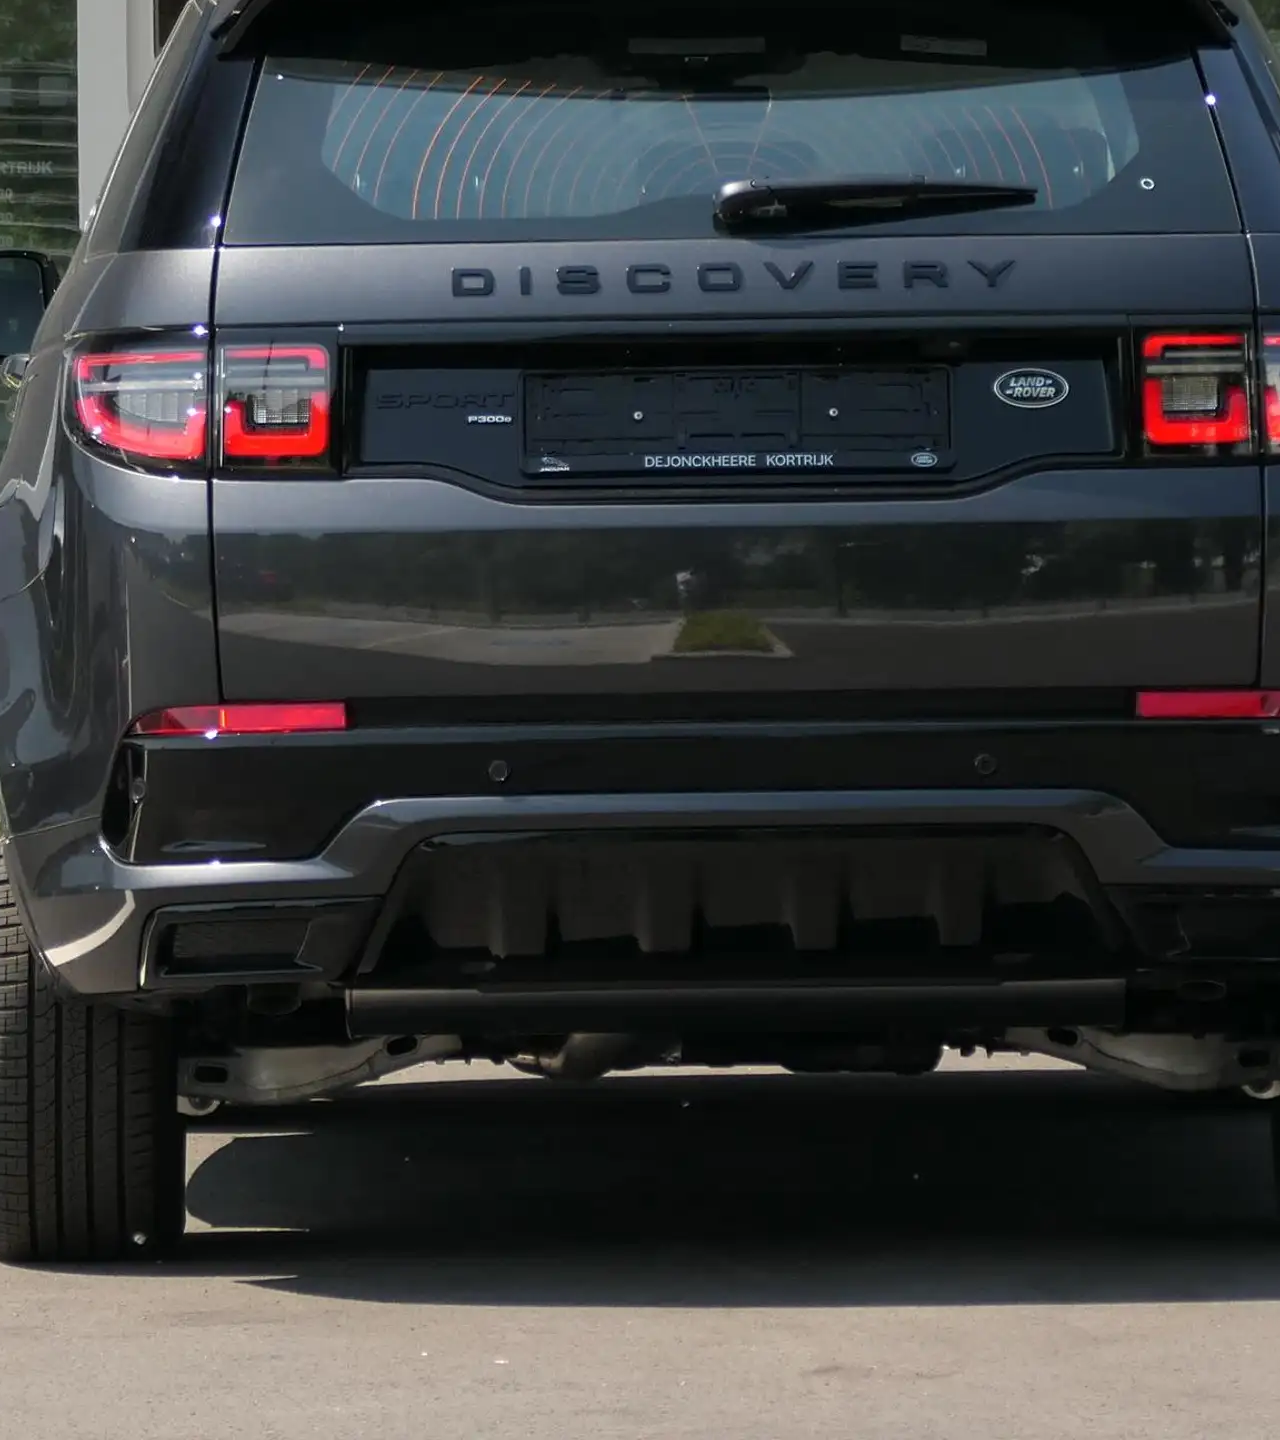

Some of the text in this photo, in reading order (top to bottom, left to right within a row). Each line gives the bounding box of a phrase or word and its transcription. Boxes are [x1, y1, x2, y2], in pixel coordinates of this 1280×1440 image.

[451, 259, 1016, 298] DISCOVERY
[1009, 376, 1045, 387] LAND
[1013, 387, 1056, 398] ROVER
[376, 392, 515, 409] SPORT
[467, 415, 512, 424] P300e
[644, 453, 834, 468] DEJONCKHEERE KORTRIJK
